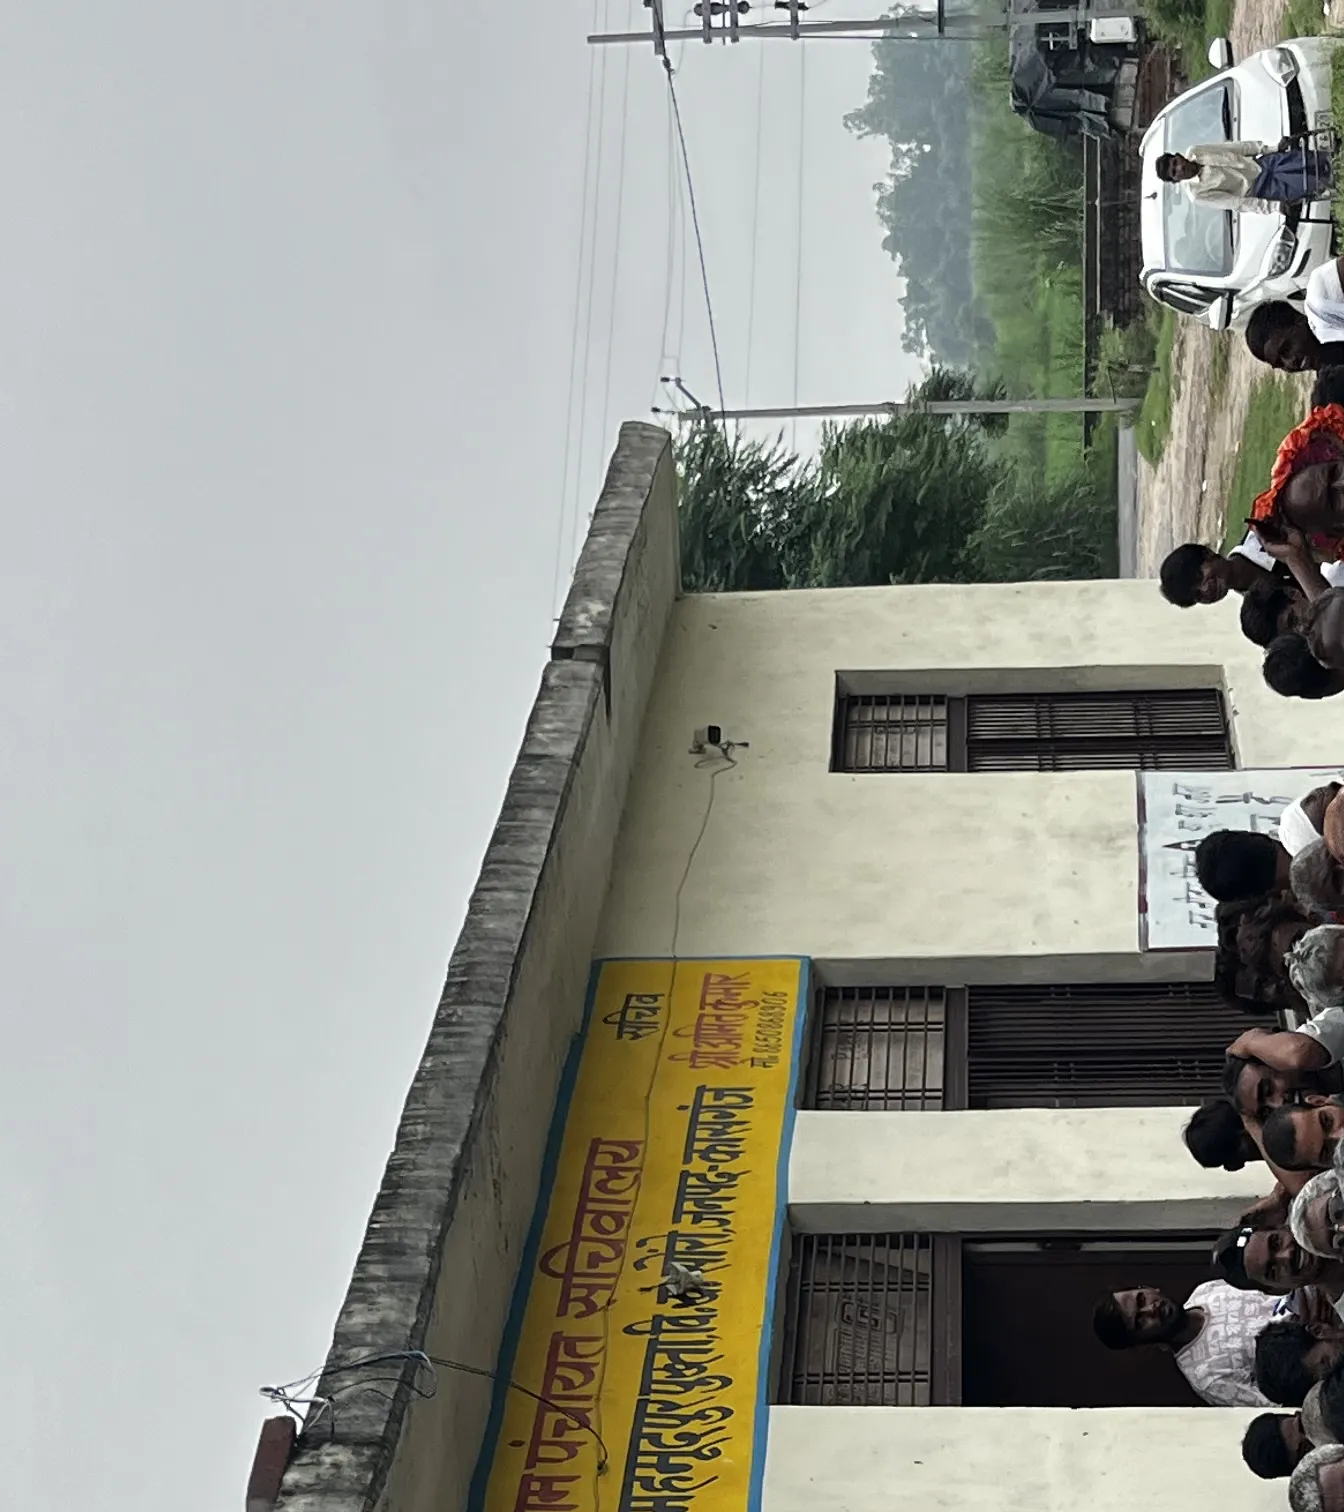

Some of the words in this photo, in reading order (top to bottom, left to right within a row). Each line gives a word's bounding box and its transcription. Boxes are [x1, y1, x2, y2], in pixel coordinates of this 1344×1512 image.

[699, 971, 760, 1011] कुमार
[602, 993, 665, 1041] सचिव
[667, 1050, 751, 1069] श्री
[538, 1137, 643, 1319] सचिवालय
[508, 1331, 605, 1470] पंचायत
